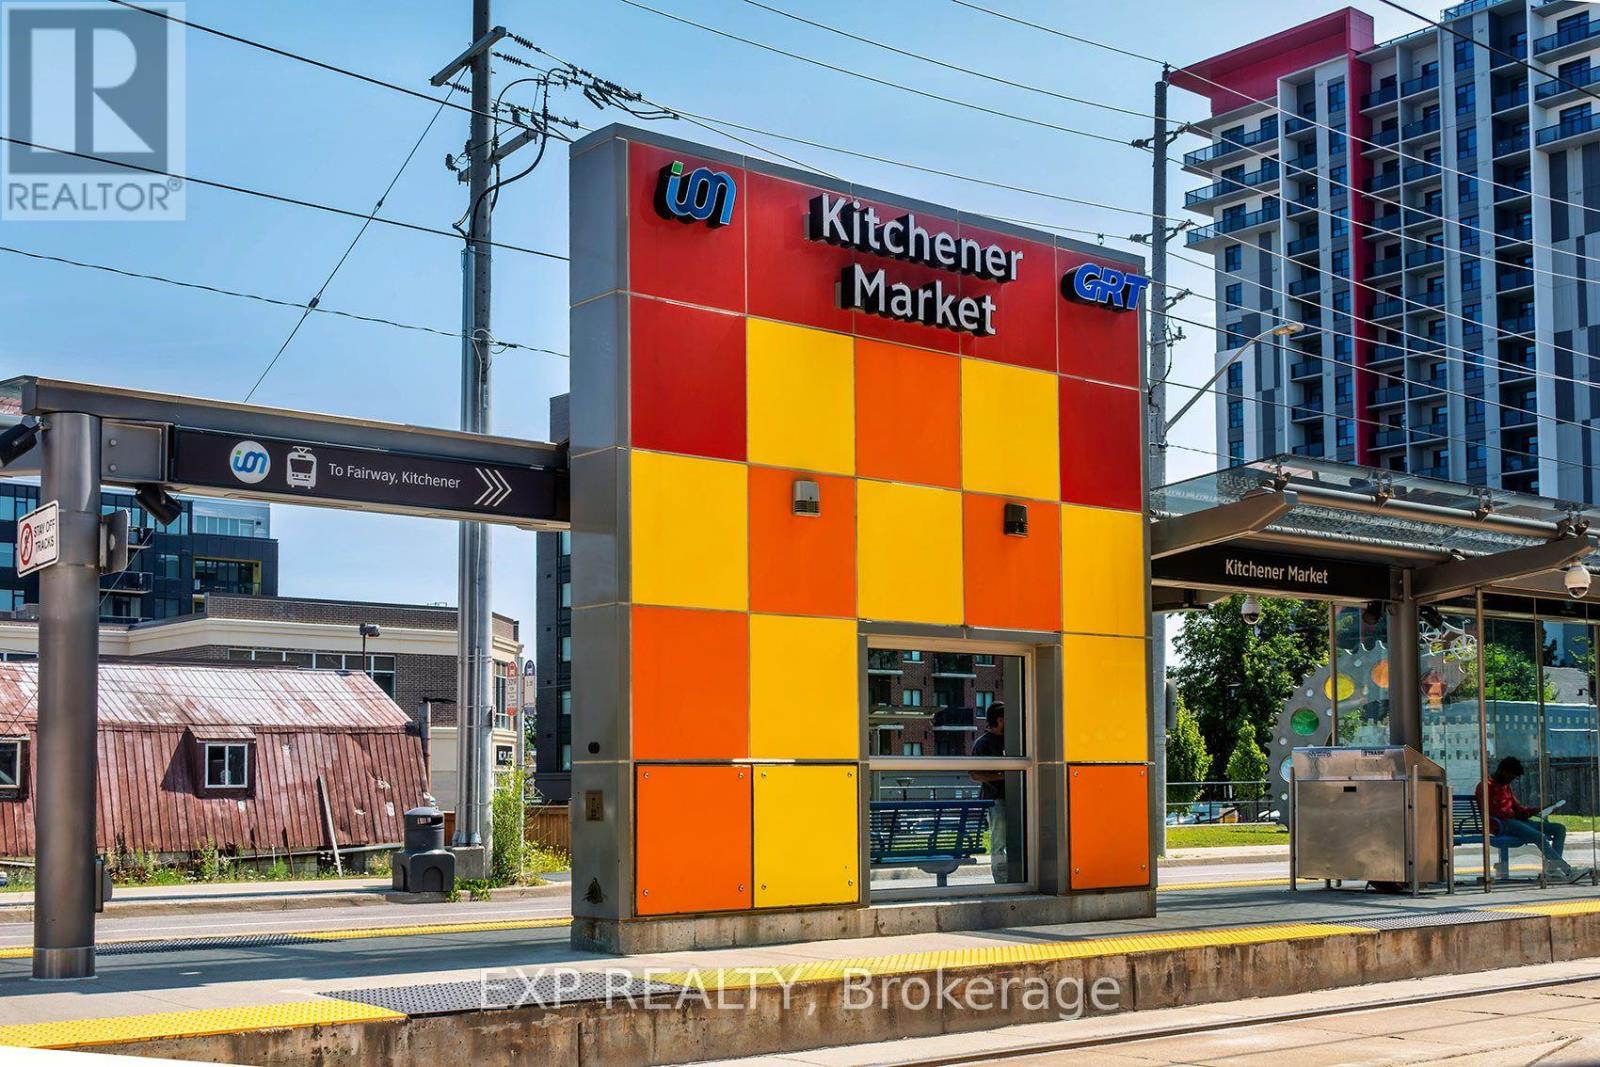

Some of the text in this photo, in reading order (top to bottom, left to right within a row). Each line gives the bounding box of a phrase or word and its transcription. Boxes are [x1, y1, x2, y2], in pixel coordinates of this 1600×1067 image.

[821, 192, 1024, 282] Kitchener
[853, 264, 997, 336] Market
[1072, 262, 1149, 312] GRT
[328, 463, 344, 478] To
[347, 465, 399, 485] Fairway,
[401, 471, 461, 489] Kitchener
[34, 518, 56, 538] STAY OFF
[35, 536, 55, 552] TRACKS
[1225, 559, 1329, 584] Kitchener Market
